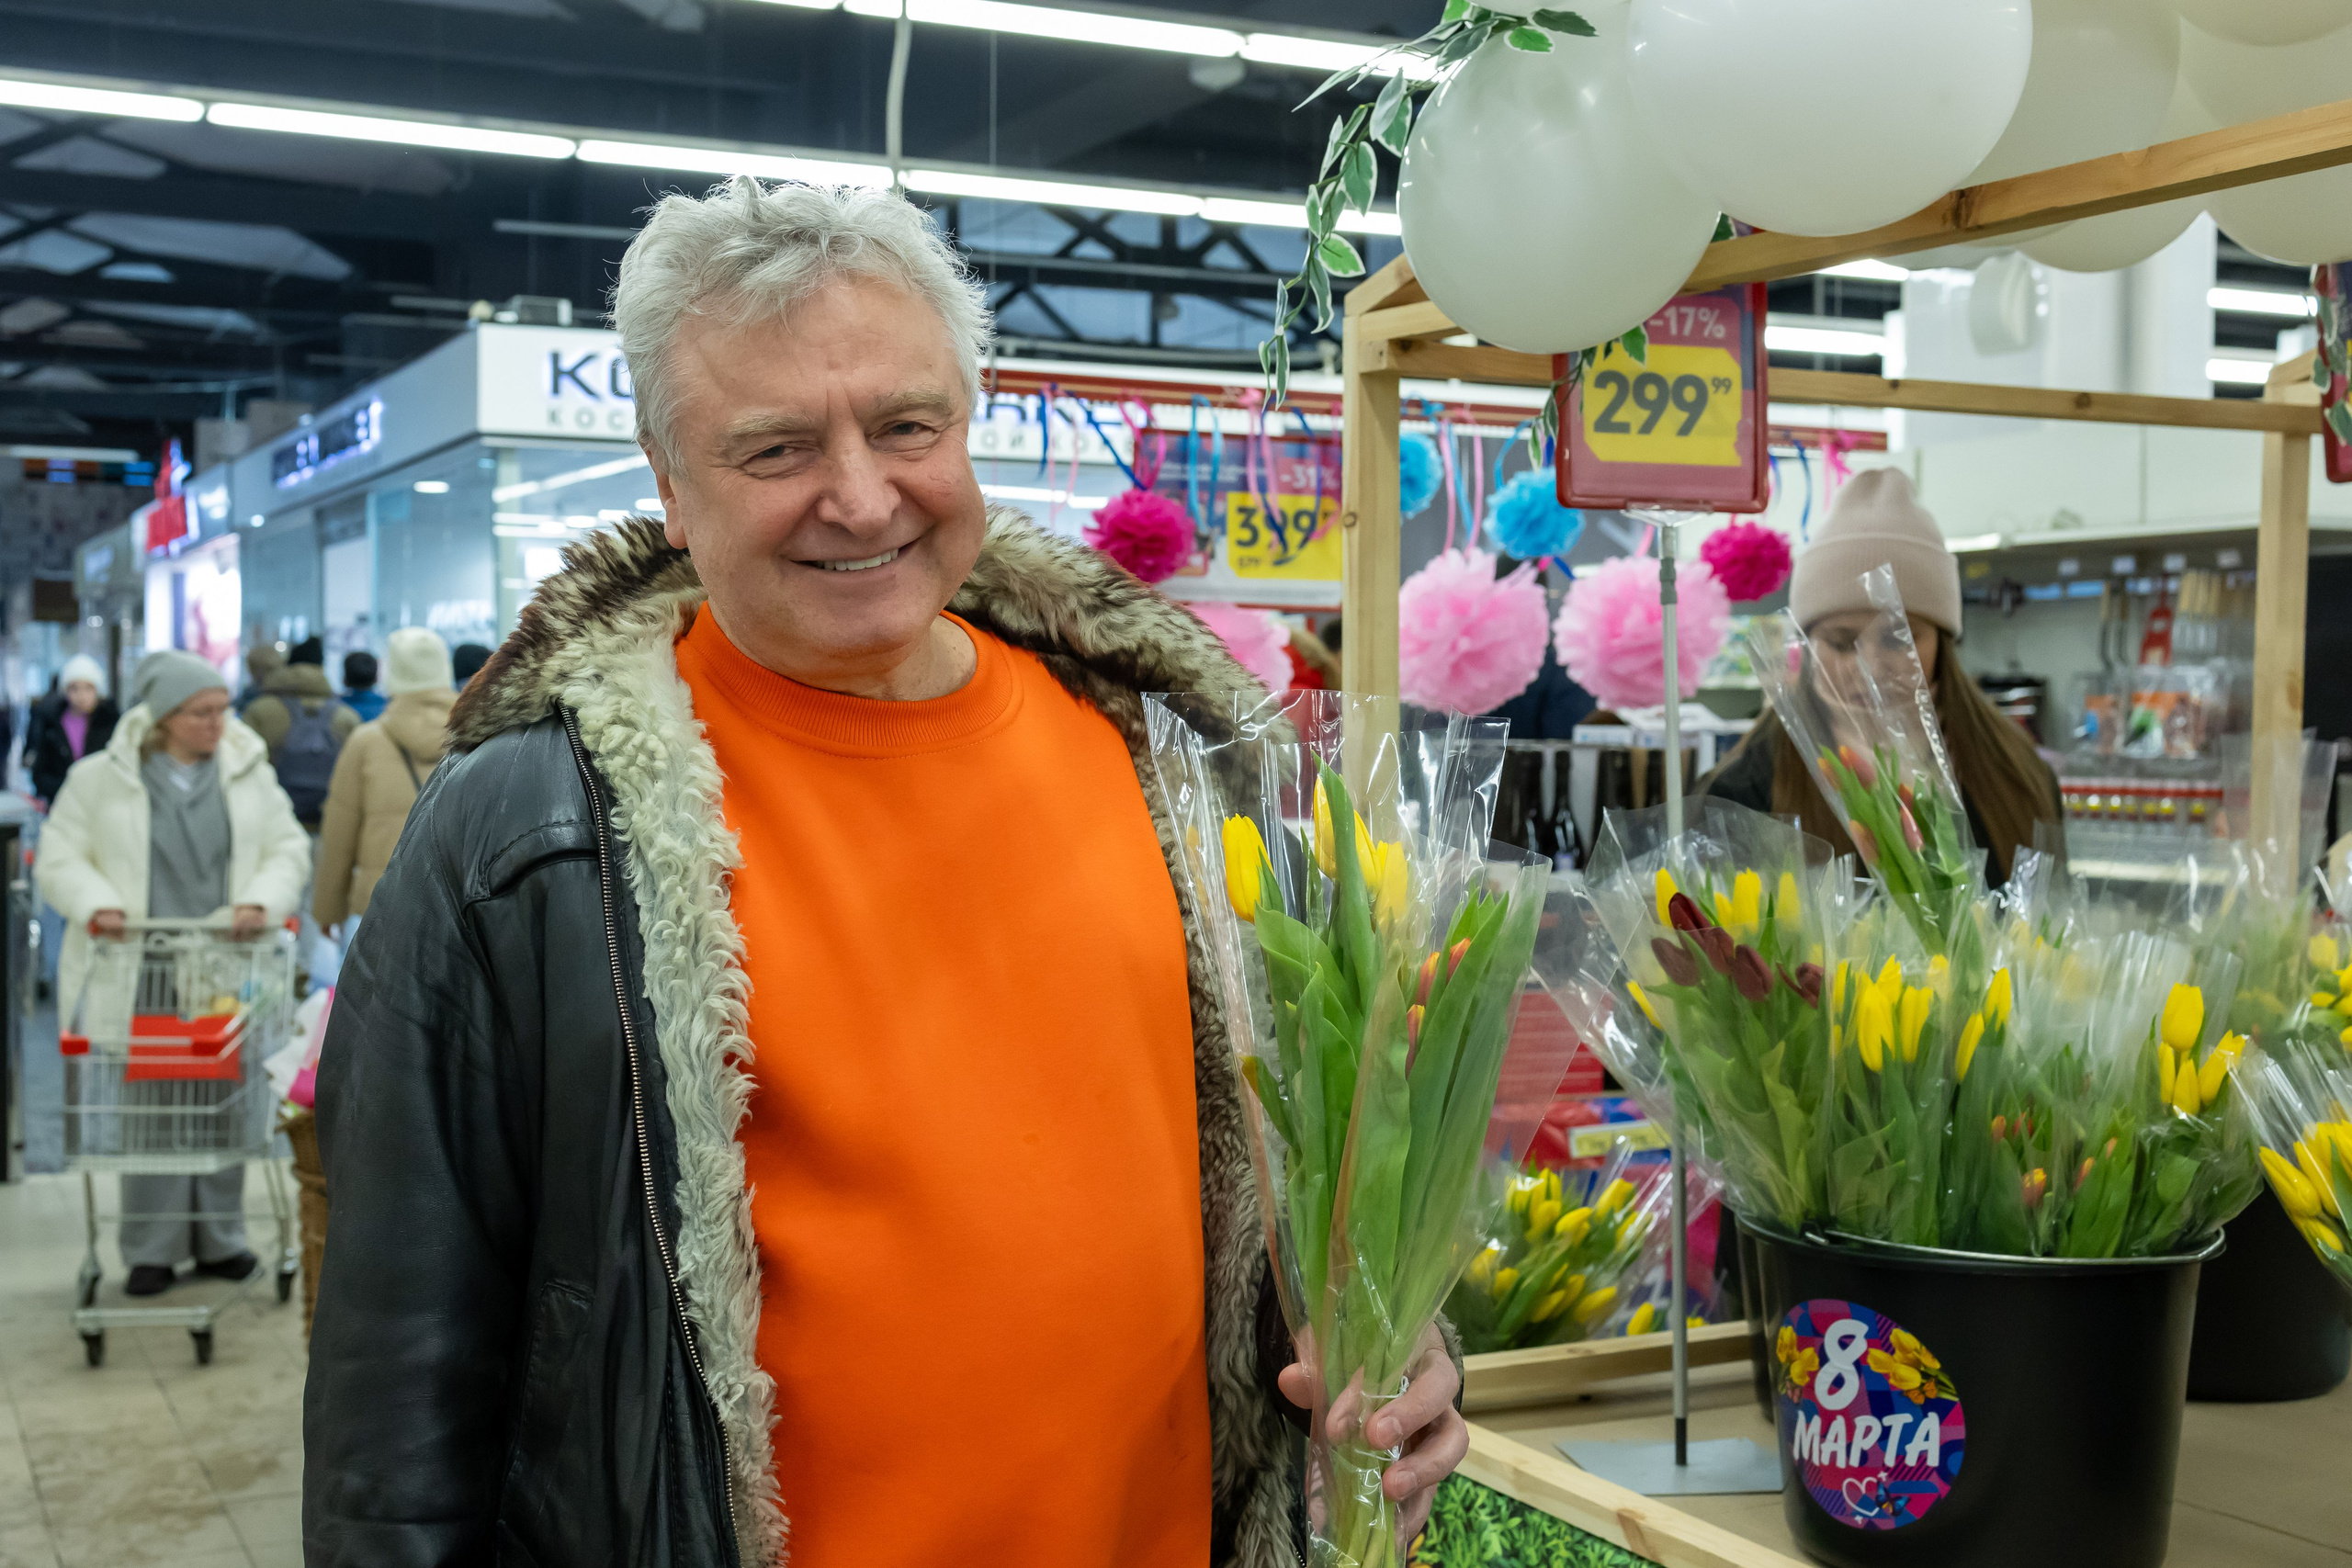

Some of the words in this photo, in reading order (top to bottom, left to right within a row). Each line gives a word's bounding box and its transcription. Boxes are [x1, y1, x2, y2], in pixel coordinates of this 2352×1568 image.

[1648, 306, 1726, 339] -17%
[551, 351, 635, 401] KO
[1593, 369, 1709, 436] 299
[1712, 377, 1732, 395] 99
[547, 407, 626, 432] КОС
[1814, 1318, 1870, 1411] 8
[1792, 1409, 1941, 1469] МАРТА
